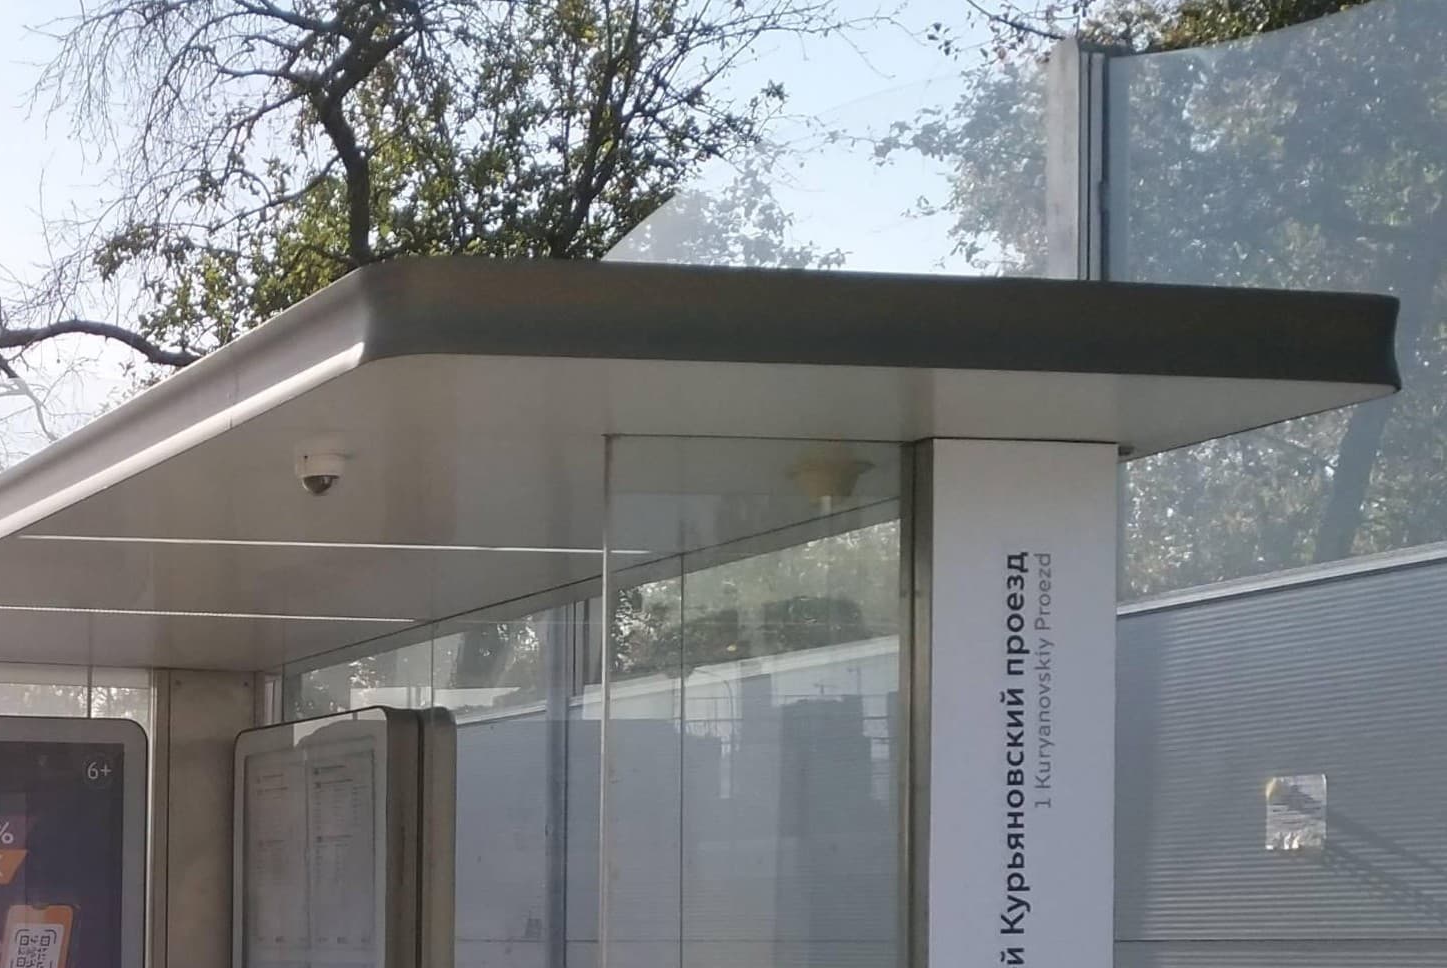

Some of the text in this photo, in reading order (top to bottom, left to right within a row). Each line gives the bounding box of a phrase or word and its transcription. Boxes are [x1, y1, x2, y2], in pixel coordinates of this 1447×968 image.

[1006, 551, 1031, 676] проезд
[1034, 552, 1056, 809] 1 Kuryanovskiy Proezd
[86, 762, 112, 780] 6+
[999, 687, 1031, 935] Курьяновский
